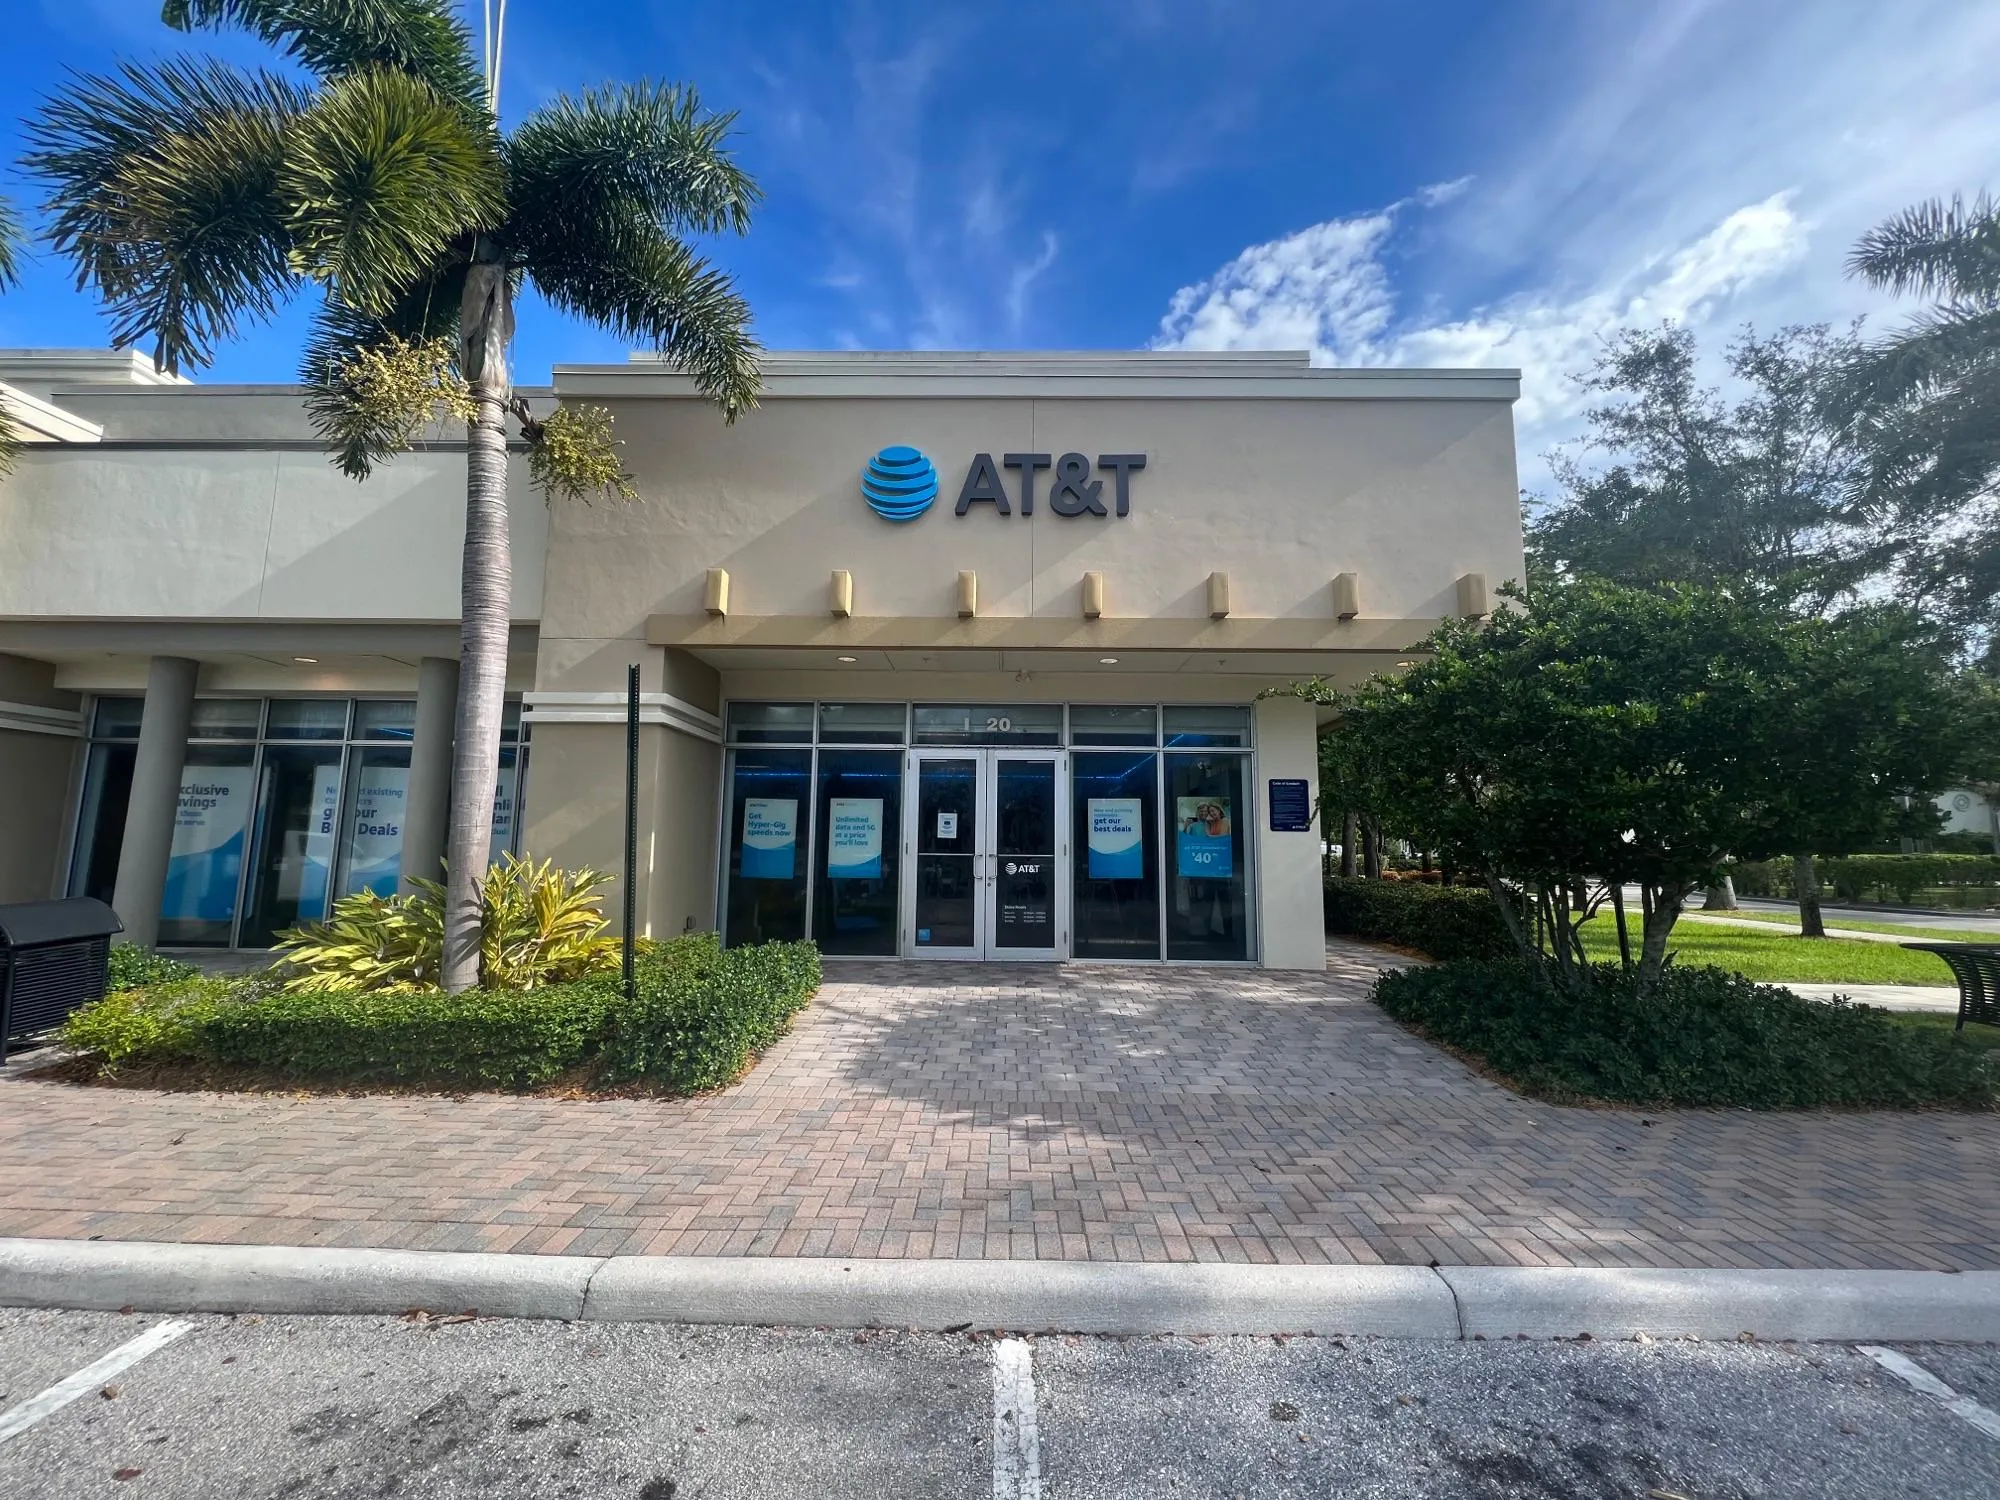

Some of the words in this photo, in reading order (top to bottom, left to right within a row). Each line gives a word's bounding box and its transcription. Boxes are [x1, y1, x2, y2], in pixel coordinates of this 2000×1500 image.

[955, 452, 1147, 518] AT&T
[179, 783, 230, 796] xclusive
[367, 787, 404, 798] existing
[358, 822, 399, 836] Deals
[1018, 864, 1040, 873] AT&T
